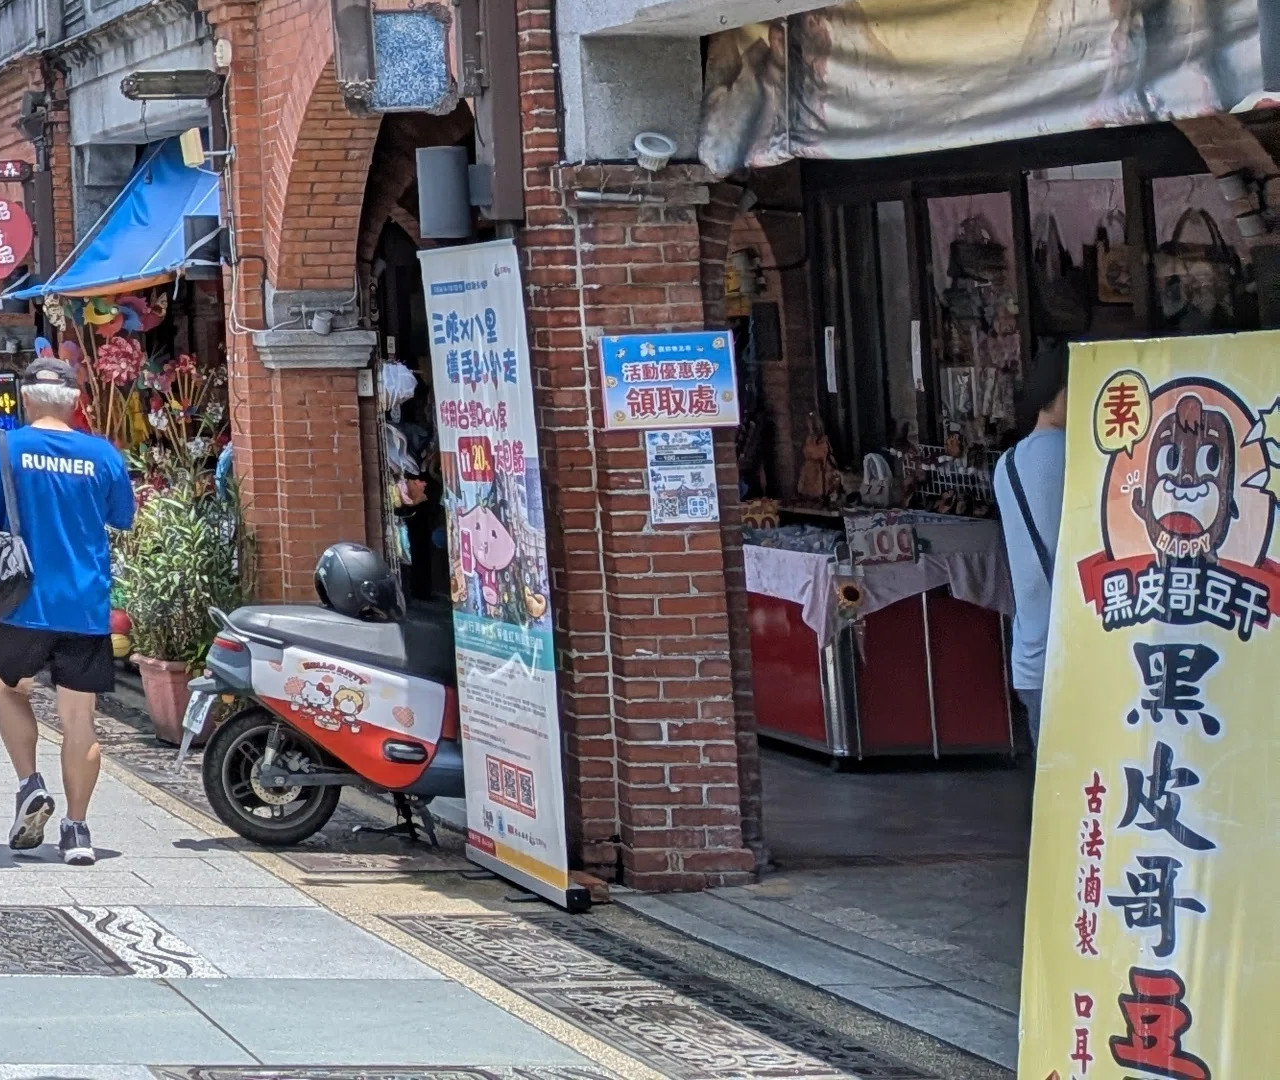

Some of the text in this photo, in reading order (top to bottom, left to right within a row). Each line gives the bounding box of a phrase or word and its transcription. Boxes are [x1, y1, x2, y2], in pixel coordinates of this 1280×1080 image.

[623, 359, 714, 382] 活動優惠券
[625, 384, 720, 418] 領取處
[1102, 382, 1141, 436] 素
[21, 453, 95, 477] RUNNER
[1156, 532, 1211, 558] HAPPY
[1104, 567, 1268, 633] 黑皮哥豆干
[337, 666, 368, 685] KITTY
[1074, 770, 1106, 957] 古法滷製
